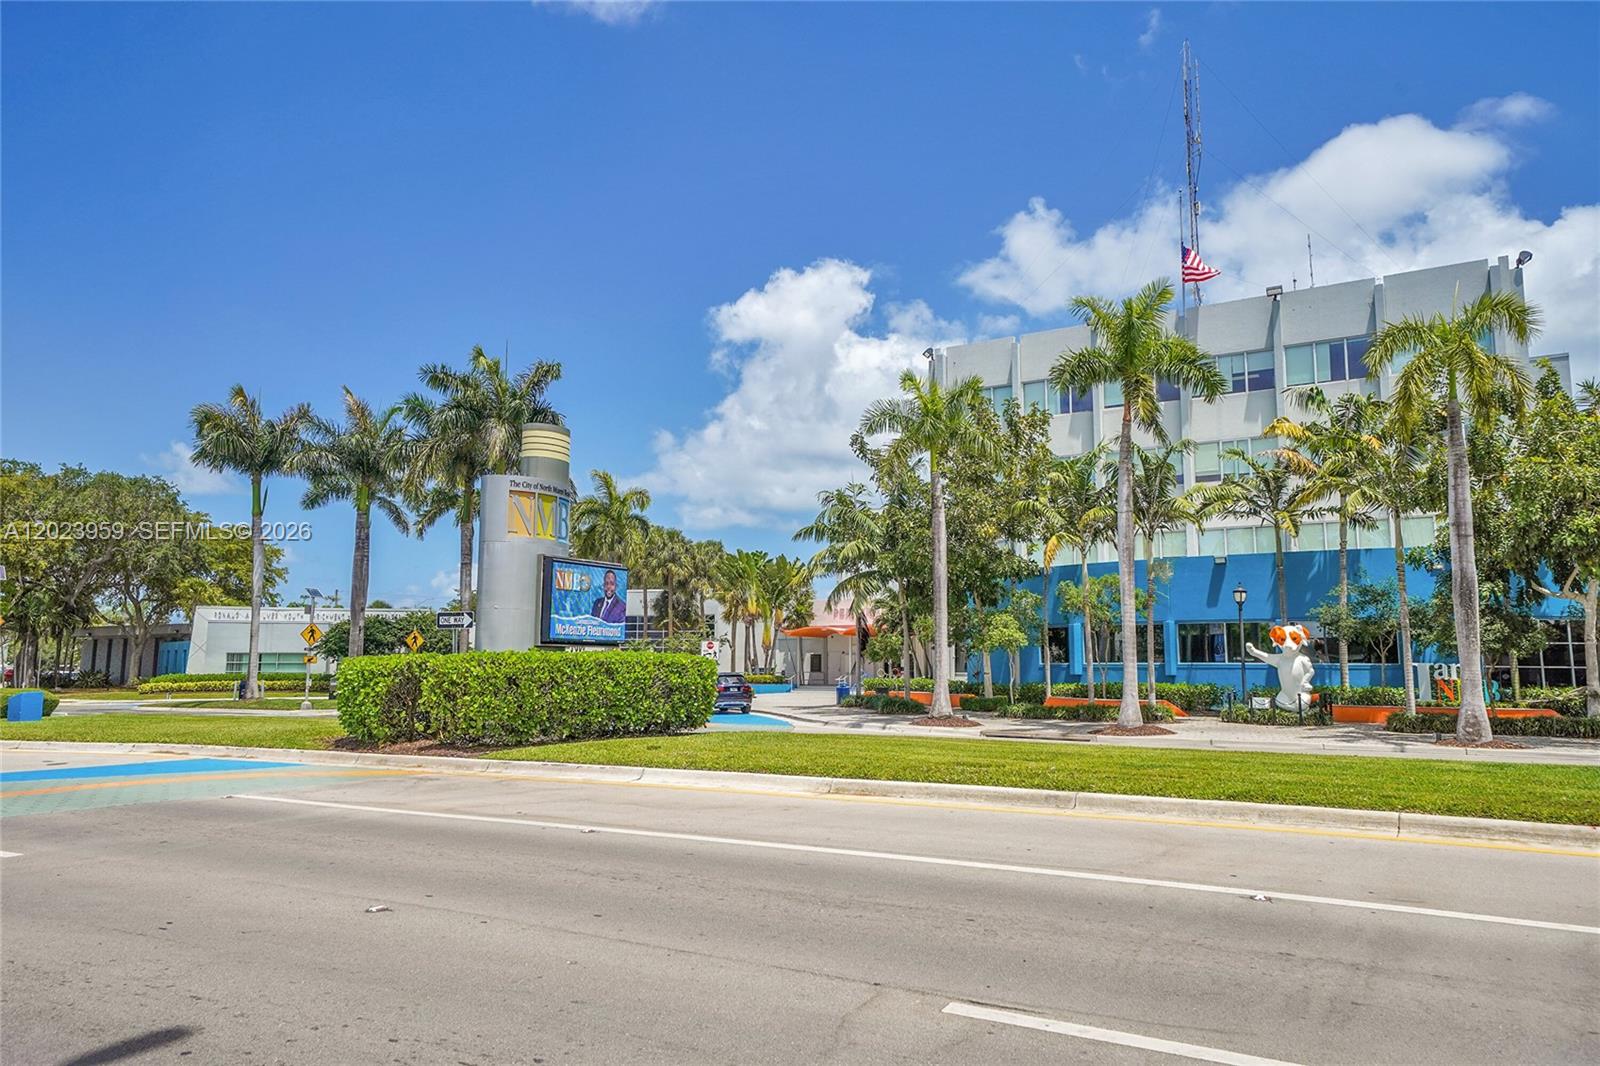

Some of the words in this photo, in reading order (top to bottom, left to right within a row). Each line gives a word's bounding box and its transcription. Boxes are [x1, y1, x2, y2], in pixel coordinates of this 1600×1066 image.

[510, 480, 521, 488] The
[522, 480, 532, 490] City
[533, 482, 539, 490] of
[508, 491, 569, 542] NMB
